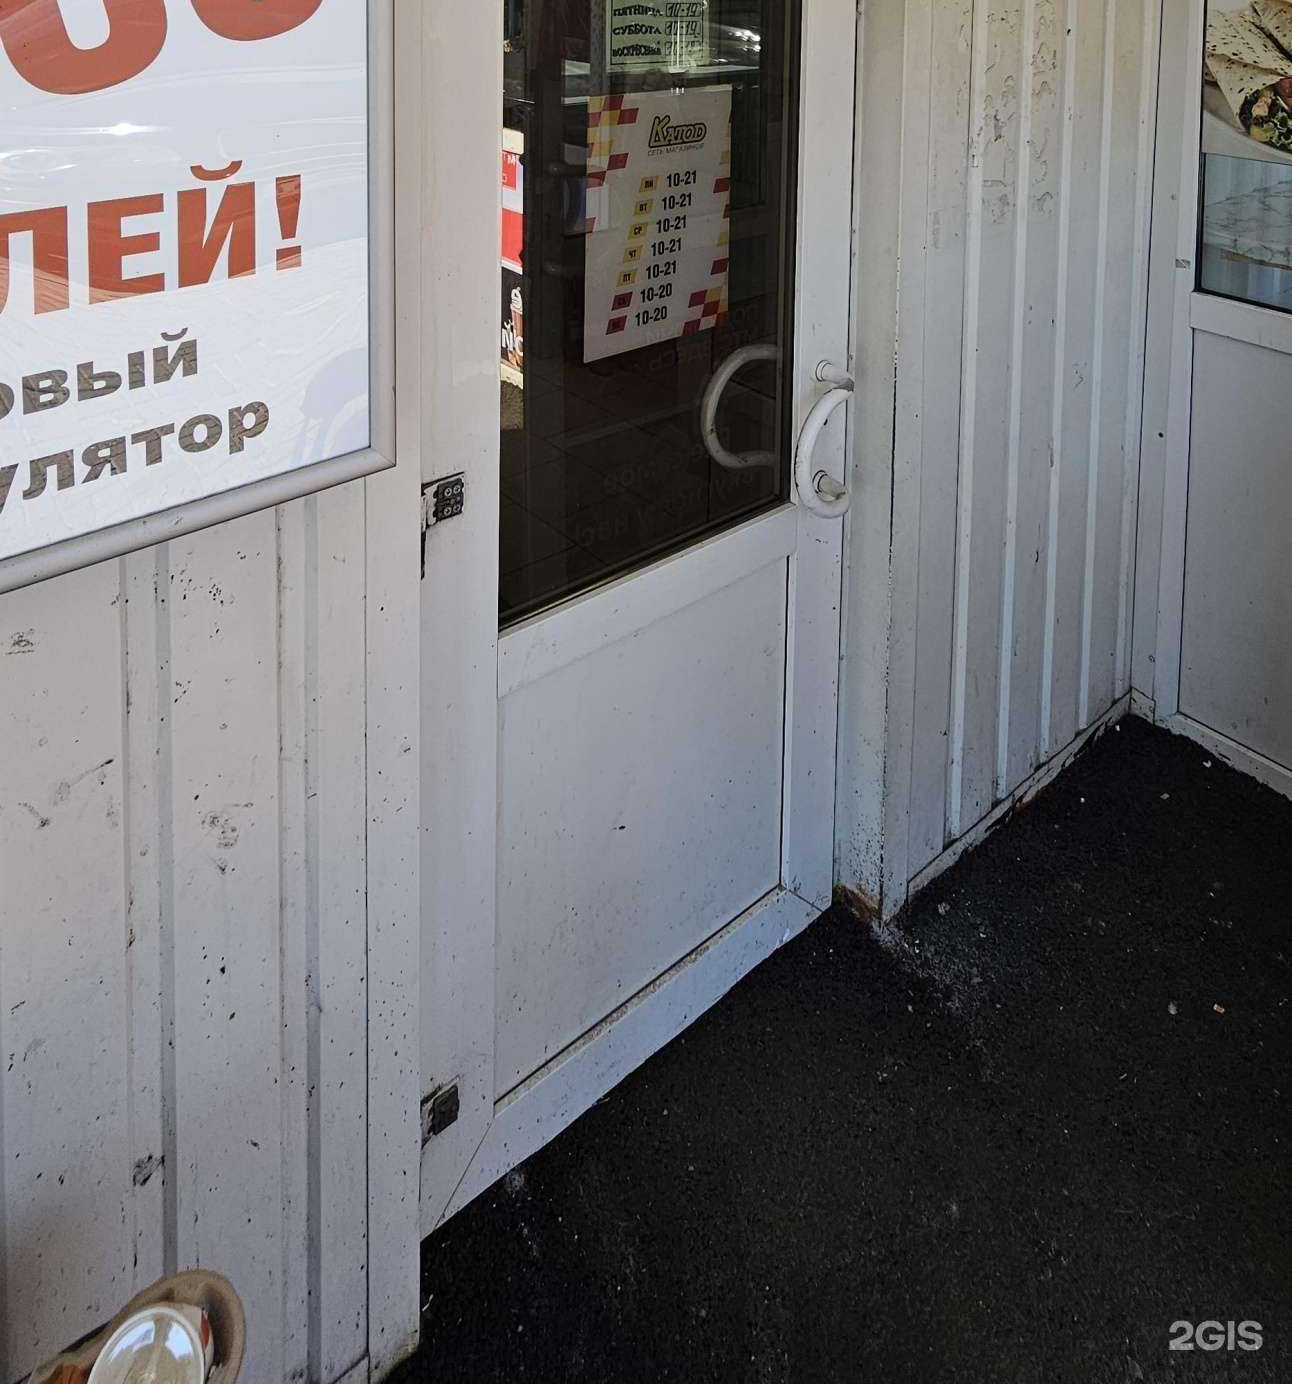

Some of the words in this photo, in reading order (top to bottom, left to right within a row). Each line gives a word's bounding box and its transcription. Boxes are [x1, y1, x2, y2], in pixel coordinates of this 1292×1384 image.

[613, 5, 663, 17] ПЯТНИЦА
[613, 24, 662, 36] СУББОТА
[666, 170, 697, 188] 10-21
[661, 192, 692, 211] 10-21
[656, 215, 687, 234] 10-21
[651, 237, 682, 256] 10-21
[645, 260, 677, 279] 10-21
[640, 283, 672, 303] 10-20
[635, 306, 667, 326] 10-20
[0, 327, 198, 419] вый
